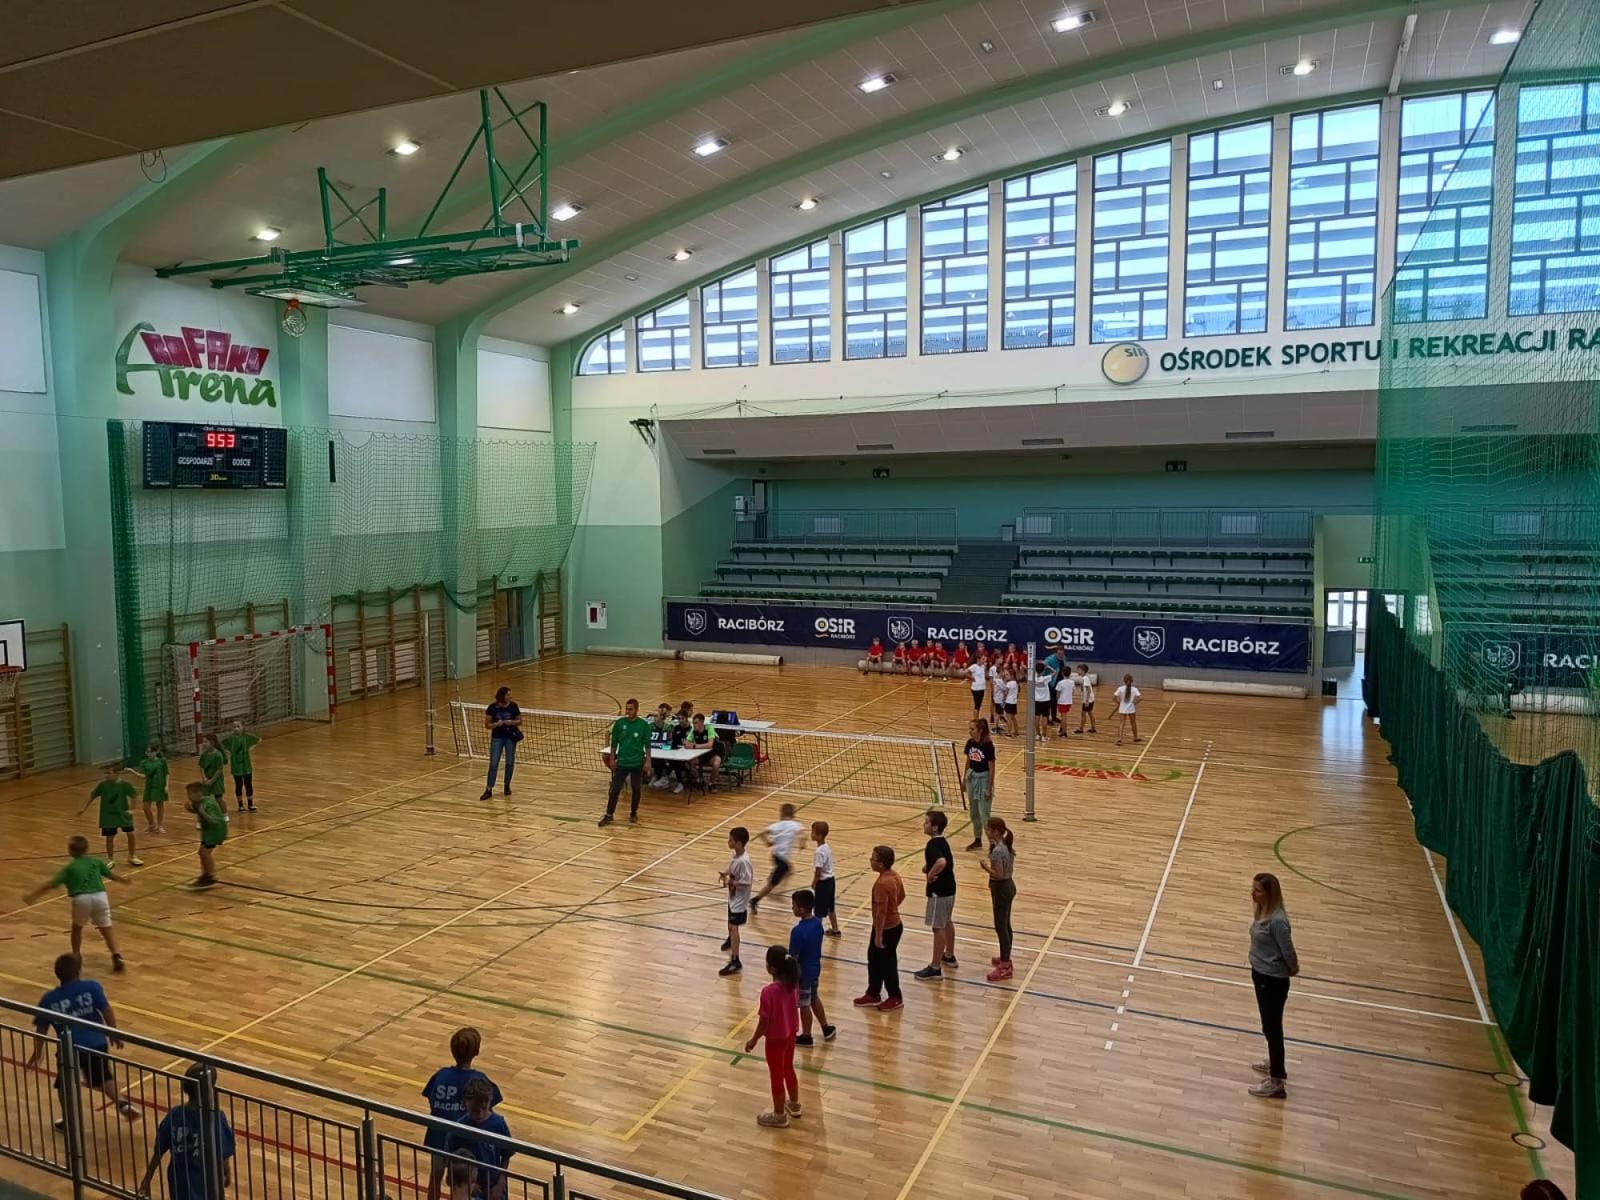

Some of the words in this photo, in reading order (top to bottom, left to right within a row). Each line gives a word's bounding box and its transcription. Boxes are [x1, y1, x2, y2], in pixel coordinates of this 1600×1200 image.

[1160, 346, 1272, 372] OŚRODEK
[1281, 340, 1381, 365] SPORTU
[1409, 330, 1556, 358] REKREACJI
[115, 321, 277, 408] Arena
[718, 616, 785, 632] RACIBÓRZ
[927, 626, 1008, 642] RACIBÓRZ
[1182, 637, 1280, 655] RACIBÓRZ
[435, 1085, 458, 1100] SP
